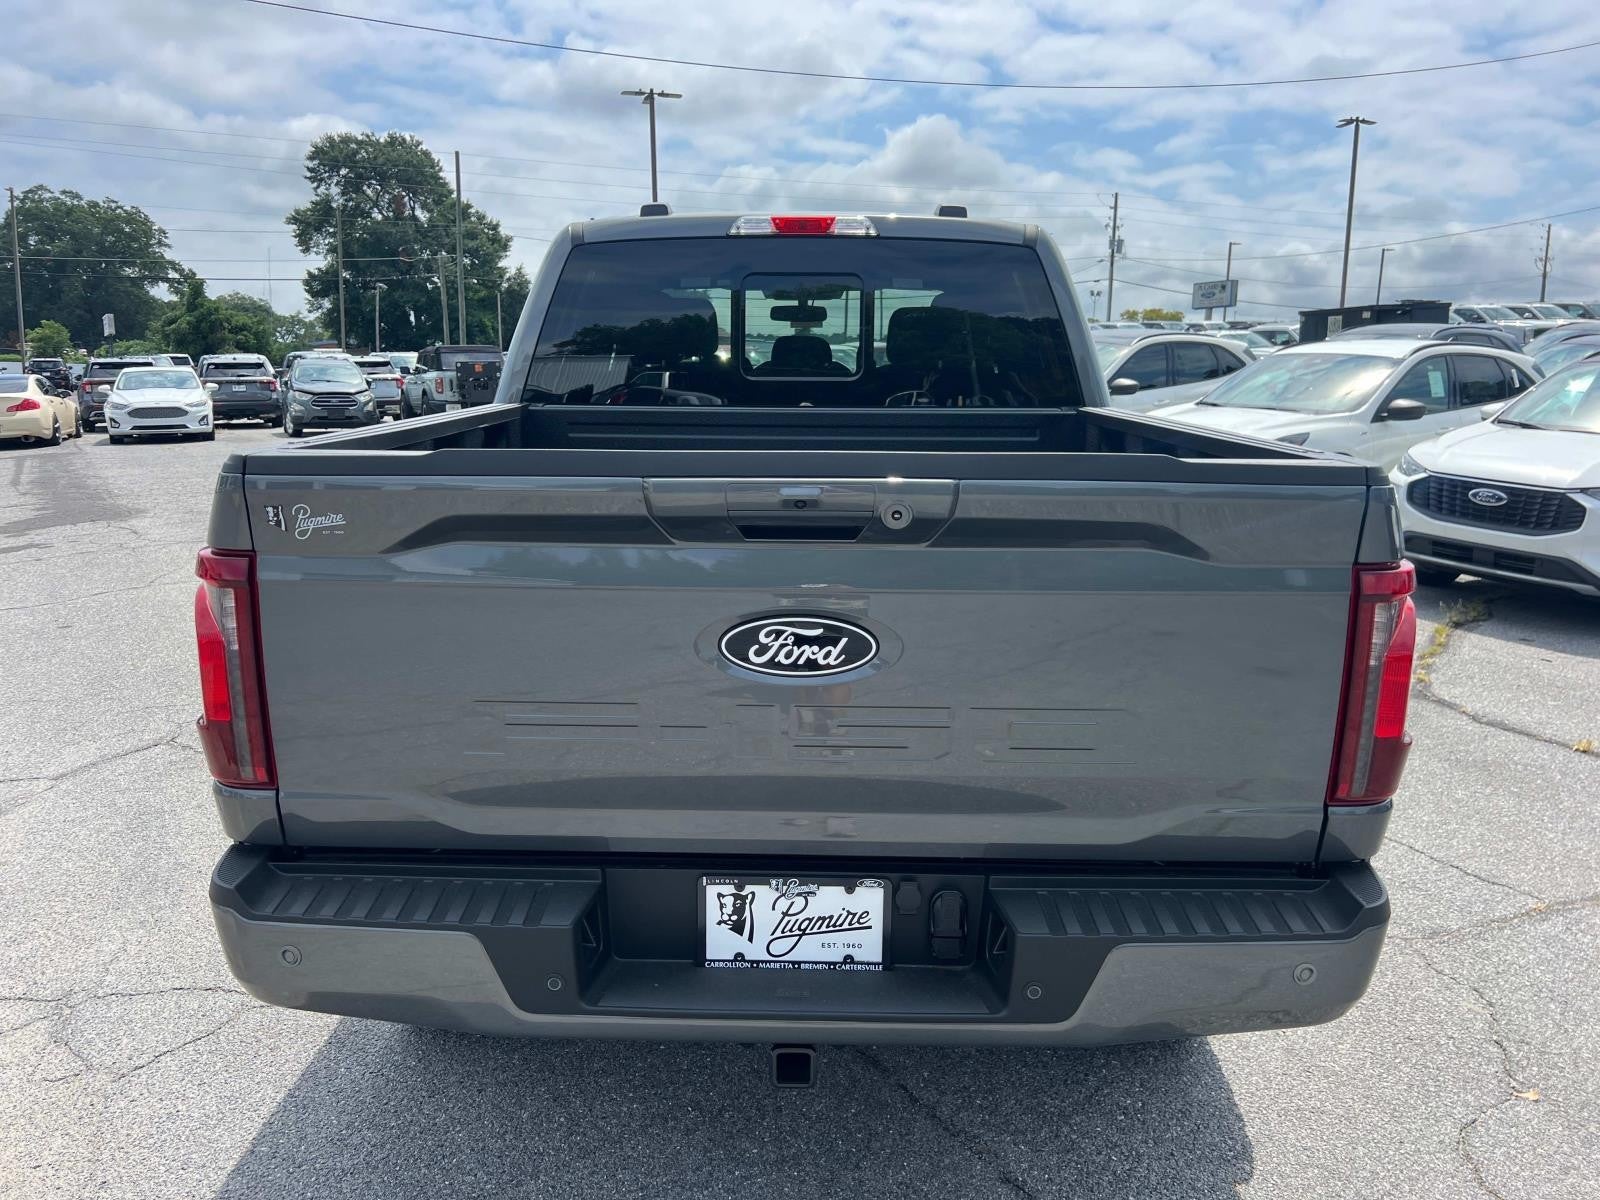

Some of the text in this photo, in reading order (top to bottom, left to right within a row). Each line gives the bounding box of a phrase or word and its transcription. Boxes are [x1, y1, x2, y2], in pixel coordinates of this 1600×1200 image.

[292, 503, 347, 540] Pugmire
[748, 625, 849, 666] Ford
[766, 892, 873, 958] Pugmire
[704, 961, 751, 969] CARROLLTON
